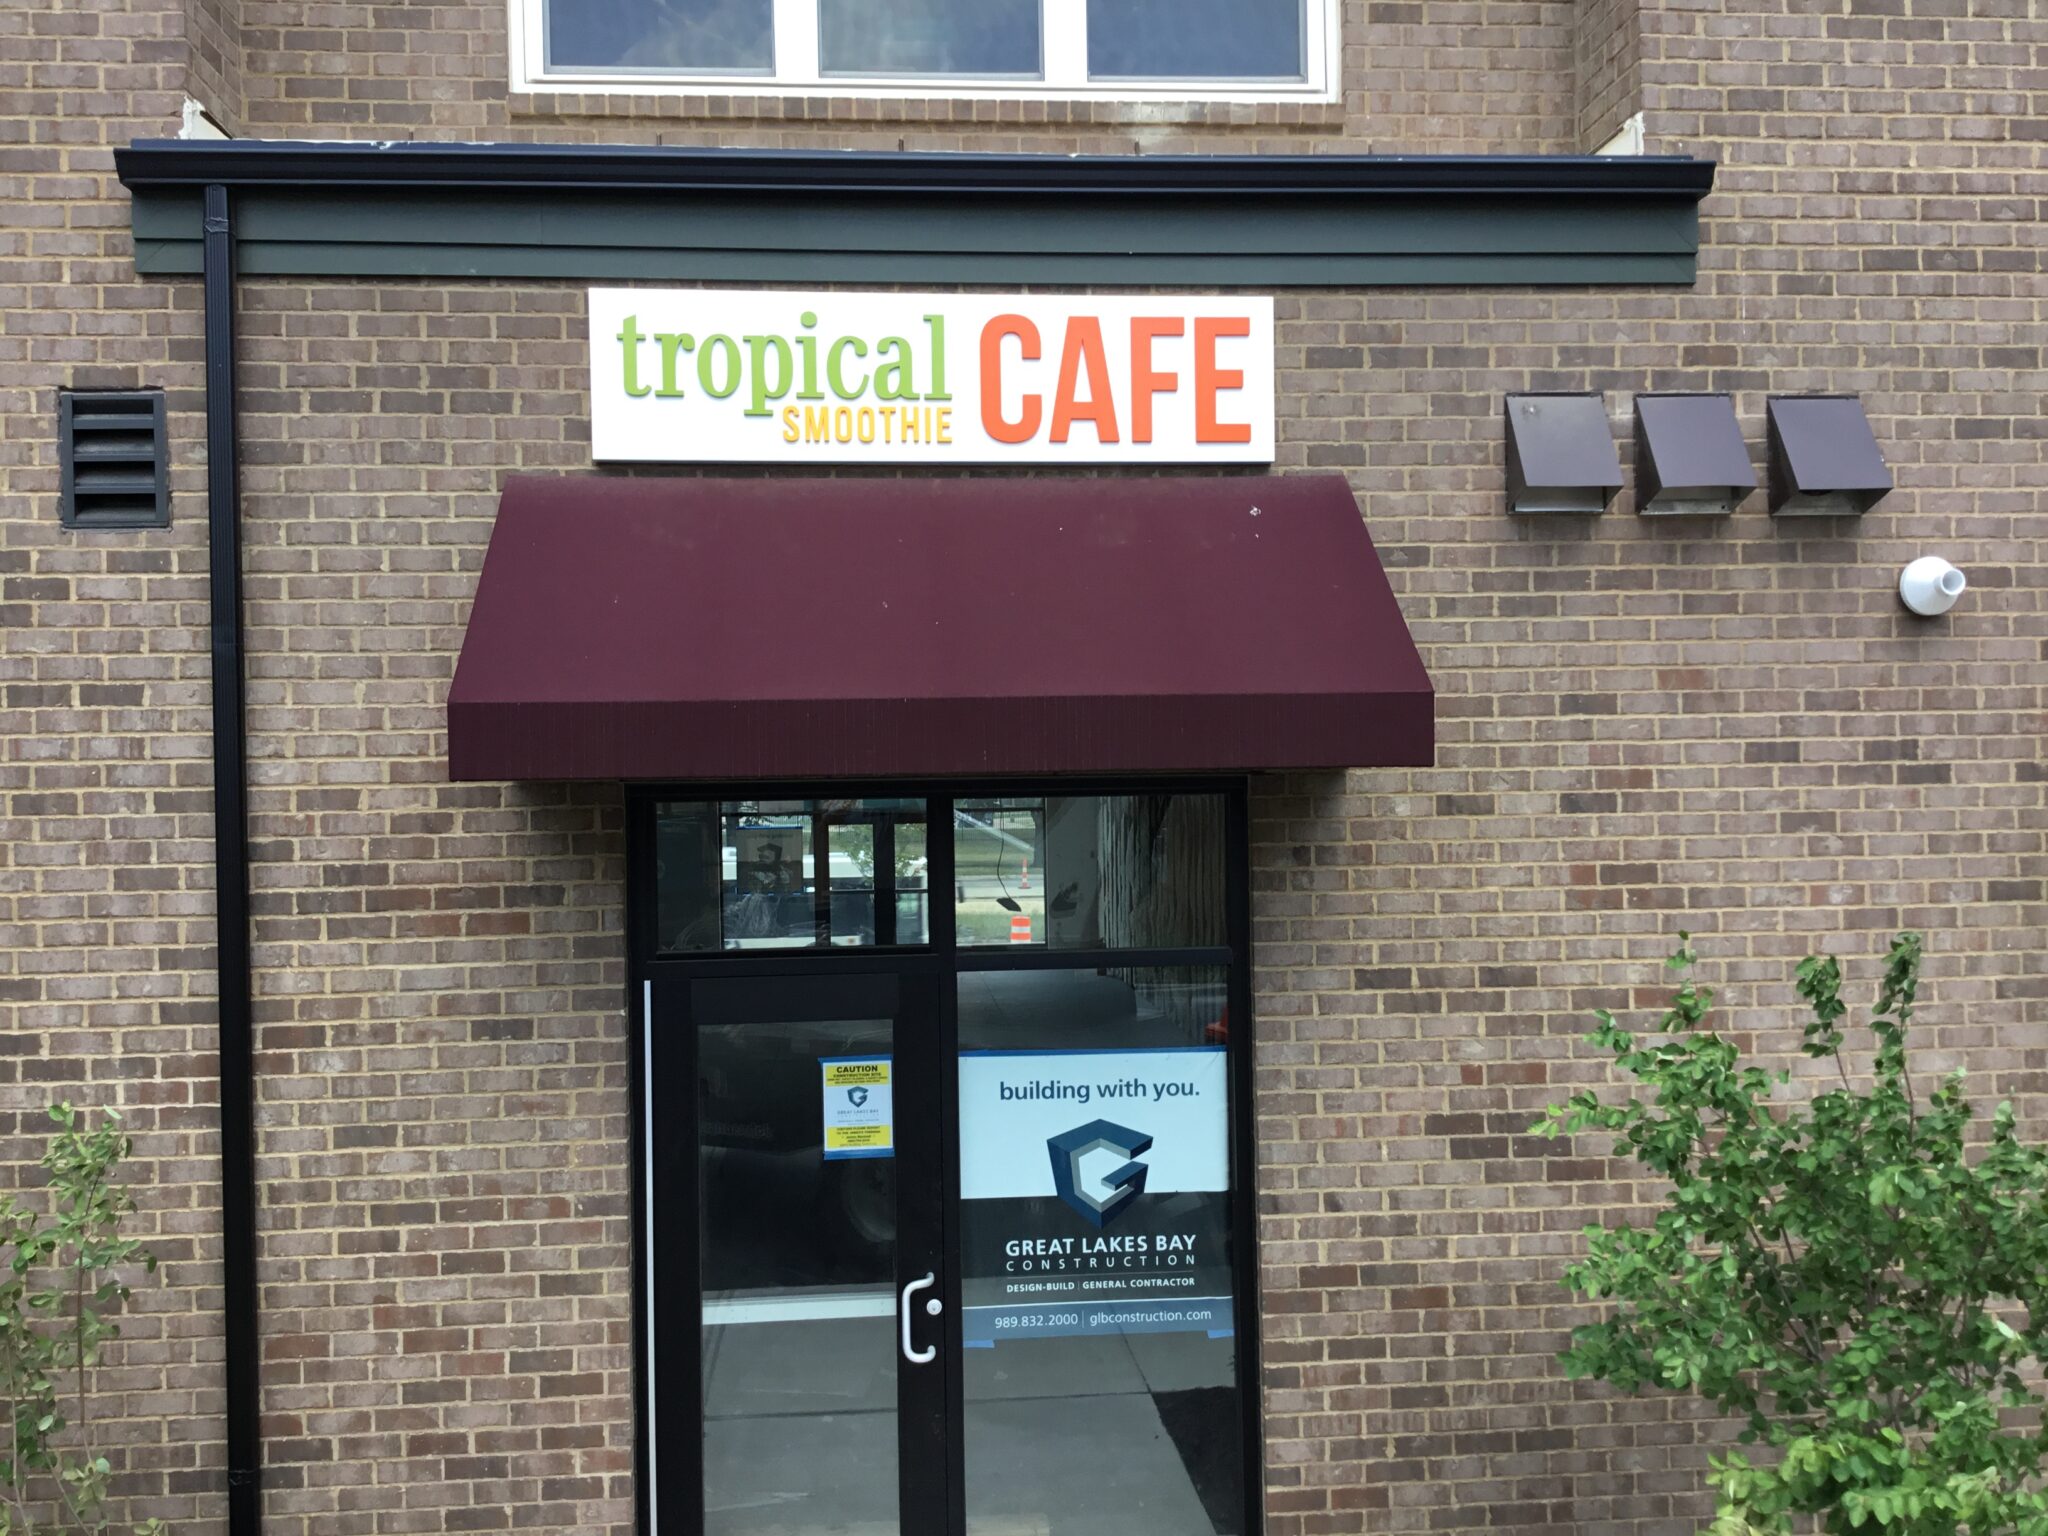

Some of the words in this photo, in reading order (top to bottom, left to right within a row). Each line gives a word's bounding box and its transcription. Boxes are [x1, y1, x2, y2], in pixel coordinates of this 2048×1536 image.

[617, 311, 953, 416] tropical
[979, 313, 1252, 444] CAFE
[782, 405, 953, 445] SMOOTHIE
[836, 1065, 878, 1073] CAUTION
[1000, 1081, 1090, 1103] building
[1097, 1078, 1147, 1098] with
[1152, 1081, 1200, 1101] you.
[1005, 1238, 1075, 1257] GREAT
[1082, 1235, 1148, 1254] LAKES
[1155, 1234, 1197, 1251] BAY
[1006, 1254, 1195, 1272] CONSTRUCTION
[1006, 1281, 1075, 1293] DESIGN-BUILD
[1082, 1279, 1127, 1290] GENERAL
[1130, 1277, 1195, 1288] CONTRACTOR
[994, 1313, 1079, 1328] 989.832.2000
[1089, 1308, 1212, 1326] glbconstruction.com
